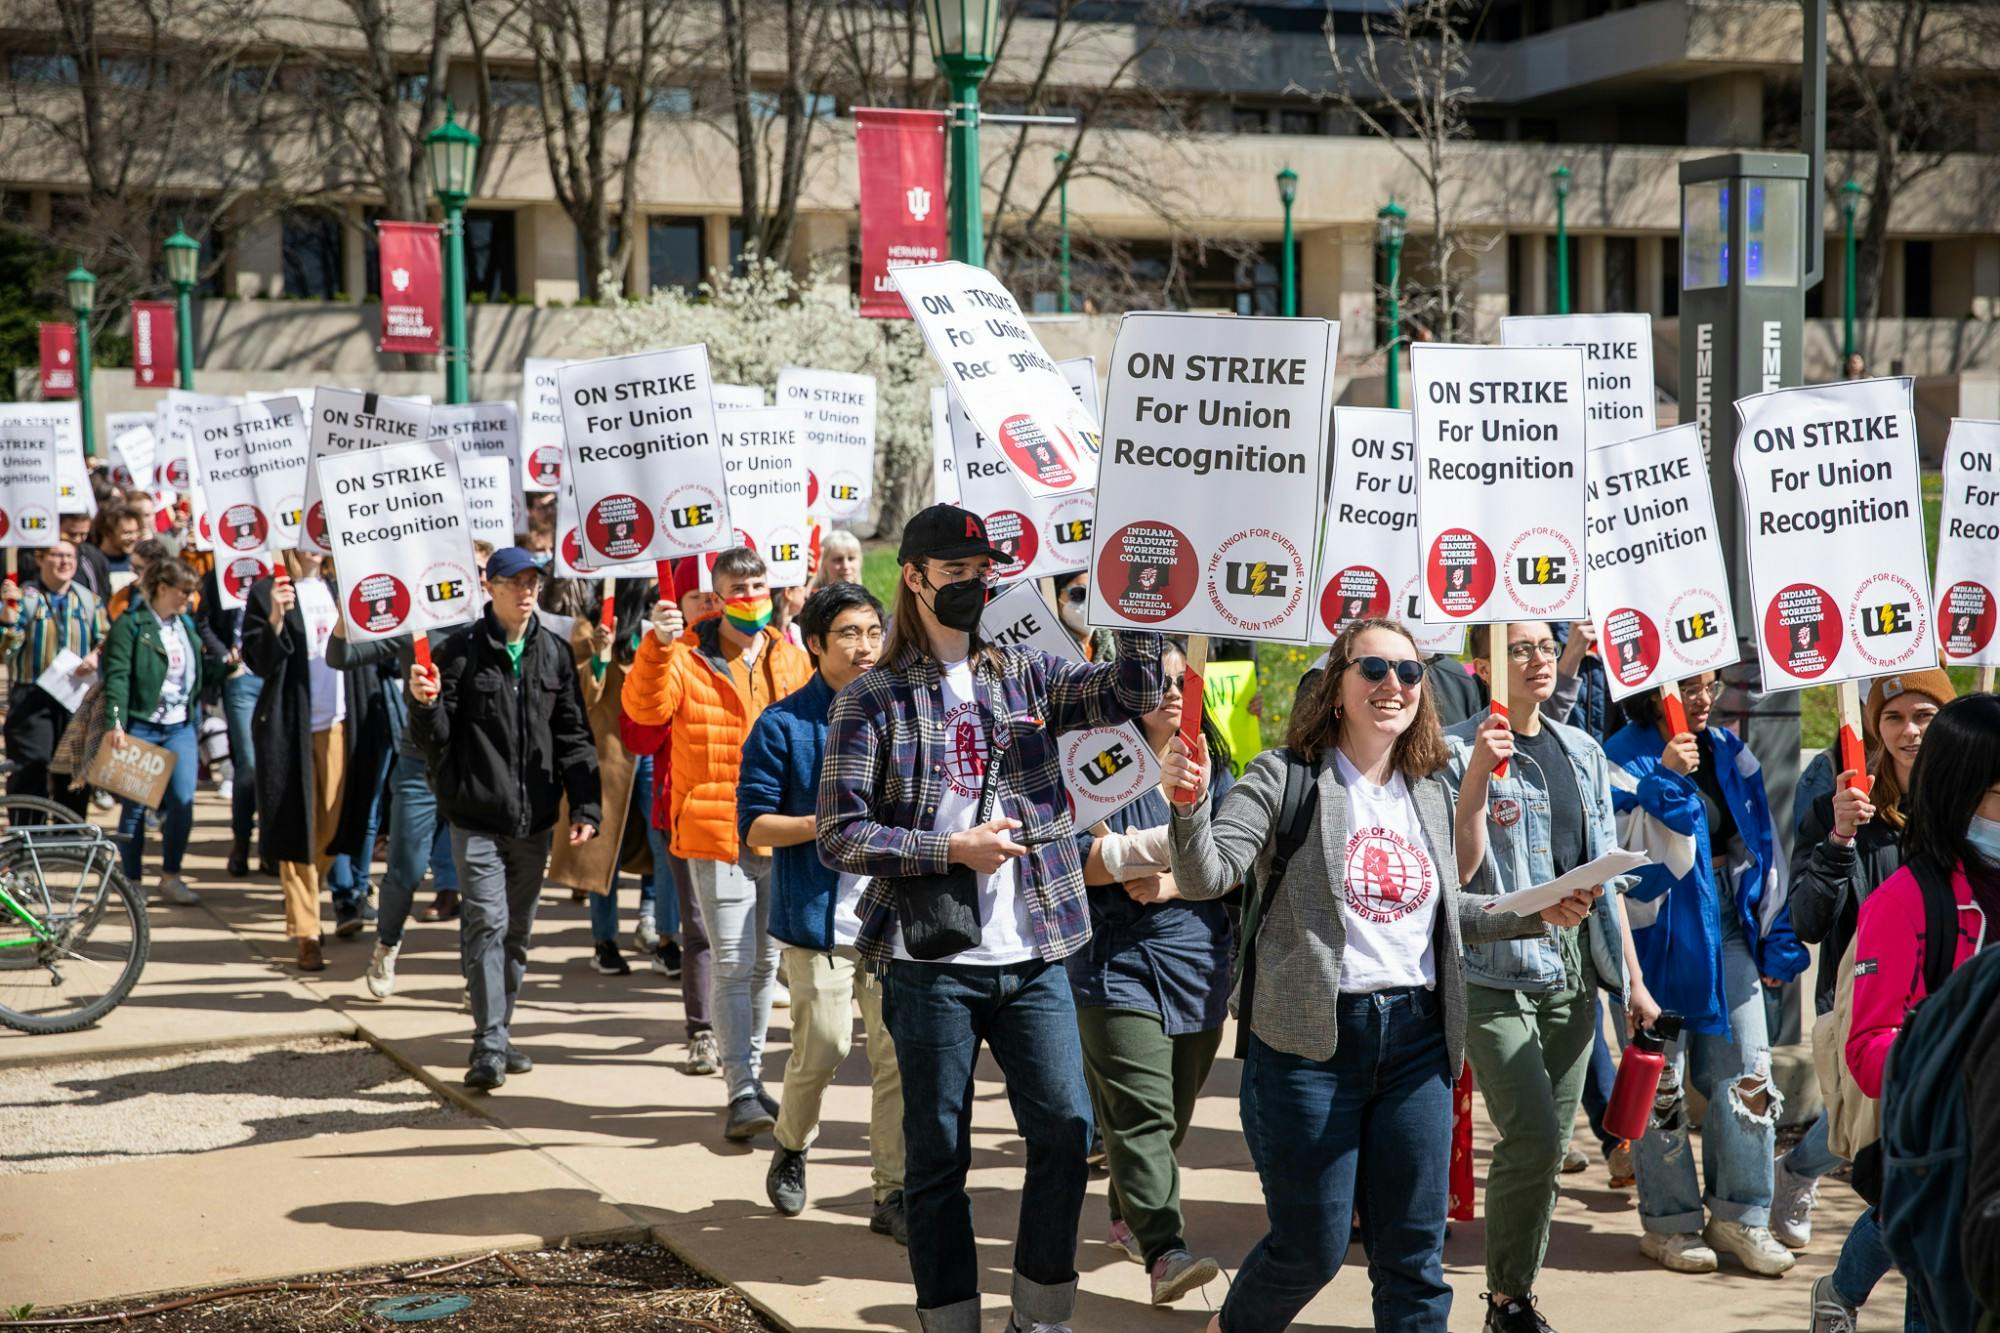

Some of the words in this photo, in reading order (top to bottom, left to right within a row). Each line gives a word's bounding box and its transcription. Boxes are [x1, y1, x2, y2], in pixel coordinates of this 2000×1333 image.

[888, 245, 927, 259] HERMAN
[922, 295, 955, 315] ON
[1127, 352, 1175, 379] ON
[1185, 355, 1306, 385] STRIKE
[574, 386, 607, 406] ON
[615, 373, 696, 402] STRIKE
[1588, 372, 1631, 390] nion
[788, 386, 809, 399] ON
[814, 389, 865, 405] STRIKE
[1429, 381, 1460, 404] ON
[1469, 382, 1568, 404] STRIKE
[323, 409, 349, 426] ON
[354, 414, 418, 438] STRIKE
[587, 416, 622, 433] For
[629, 406, 692, 428] Union
[819, 411, 859, 424] Union
[1136, 396, 1188, 423] For
[1199, 399, 1291, 429] Union
[204, 426, 229, 442] ON
[233, 413, 295, 437] STRIKE
[454, 420, 508, 434] STRIKE
[740, 430, 795, 446] STRIKE
[808, 431, 866, 445] ognition
[1439, 420, 1473, 442] For
[1482, 419, 1558, 442] Union
[1754, 426, 1795, 453] ON
[1803, 415, 1899, 448] STRIKE
[215, 448, 240, 461] For
[245, 437, 293, 455] Union
[328, 432, 356, 449] For
[462, 440, 504, 452] Union
[579, 432, 709, 463] Recognition
[1352, 438, 1384, 459] ON
[3, 457, 41, 467] Union
[748, 457, 792, 471] Union
[1115, 439, 1306, 475] Recognition
[1960, 452, 1991, 472] ON
[210, 456, 306, 482] Recognition
[336, 476, 365, 495] ON
[372, 462, 447, 488] STRIKE
[1429, 457, 1574, 485] Recognition
[1605, 457, 1691, 496] STRIKE
[1771, 469, 1810, 492] For
[1818, 459, 1892, 487] Union
[730, 480, 800, 498] cognition
[831, 485, 858, 500] UE
[1356, 472, 1391, 493] For
[349, 502, 379, 519] For
[386, 491, 443, 511] Union
[598, 502, 637, 512] GRADUATE
[600, 498, 632, 506] INDIANA
[1624, 496, 1688, 525] Union
[599, 514, 638, 524] COALITION
[671, 504, 714, 529] UE
[965, 516, 982, 538] A
[1340, 504, 1417, 531] Recogn
[1760, 498, 1909, 535] Recognition
[341, 513, 460, 546] Recognition
[1055, 519, 1092, 544] UE
[1127, 527, 1174, 538] INDIANA
[771, 544, 799, 561] UE
[1122, 537, 1178, 547] GRADUATE
[1124, 546, 1176, 556] WORKERS
[1208, 552, 1221, 573] THE
[1219, 531, 1248, 553] UNION
[1249, 528, 1269, 537] FOR
[1271, 532, 1305, 578] EVERYONE
[1504, 552, 1513, 568] THE
[1510, 531, 1531, 550] UNION
[1550, 529, 1579, 566] EVERYONE
[1120, 553, 1178, 565] COALITION
[1226, 561, 1288, 597] UE
[1517, 557, 1566, 584] UE
[426, 580, 464, 603] UE
[1129, 592, 1163, 600] UNITED
[1337, 590, 1377, 598] COALITION
[1504, 576, 1528, 611] MEMBERS
[1530, 606, 1546, 615] RUN
[1549, 599, 1565, 612] THIS
[1564, 574, 1580, 600] UNION
[1778, 597, 1822, 608] GRADUATE
[1780, 589, 1817, 600] INDIANA
[1855, 578, 1872, 601] UNION
[1873, 573, 1889, 582] FOR
[1891, 574, 1924, 611] EVERYONE
[1118, 600, 1172, 609] ELECTRICAL
[1123, 607, 1166, 616] WORKERS
[1208, 580, 1238, 626] MEMBERS
[1239, 620, 1260, 631] RUN
[1262, 614, 1284, 630] THIS
[1283, 586, 1303, 618] UNION
[1781, 605, 1821, 617] WORKERS
[1676, 610, 1718, 644] UE
[1780, 613, 1824, 626] COALITION
[1861, 602, 1912, 637] UE
[1794, 650, 1818, 658] UNITED
[1850, 629, 1877, 665] MEMBERS
[1879, 659, 1896, 667] RUN
[1897, 647, 1914, 662] THIS
[1913, 619, 1925, 648] UNION
[1794, 663, 1824, 673] WORKERS
[1067, 742, 1079, 766] UNION
[1077, 730, 1092, 743] FOR
[1095, 727, 1135, 744] EVERYONE
[112, 745, 165, 775] GRAD
[1079, 743, 1133, 785] UE
[1135, 748, 1146, 775] UNION
[1132, 776, 1144, 790] THIS
[1077, 786, 1115, 803] MEMBERS
[1117, 789, 1133, 800] RUN
[982, 789, 995, 825] AGGU
[1371, 827, 1385, 836] OF
[1390, 829, 1405, 846] THE
[1408, 843, 1431, 877] WORLD
[1406, 881, 1432, 913] UNITED
[1373, 914, 1392, 923] THE
[1394, 912, 1404, 920] IN
